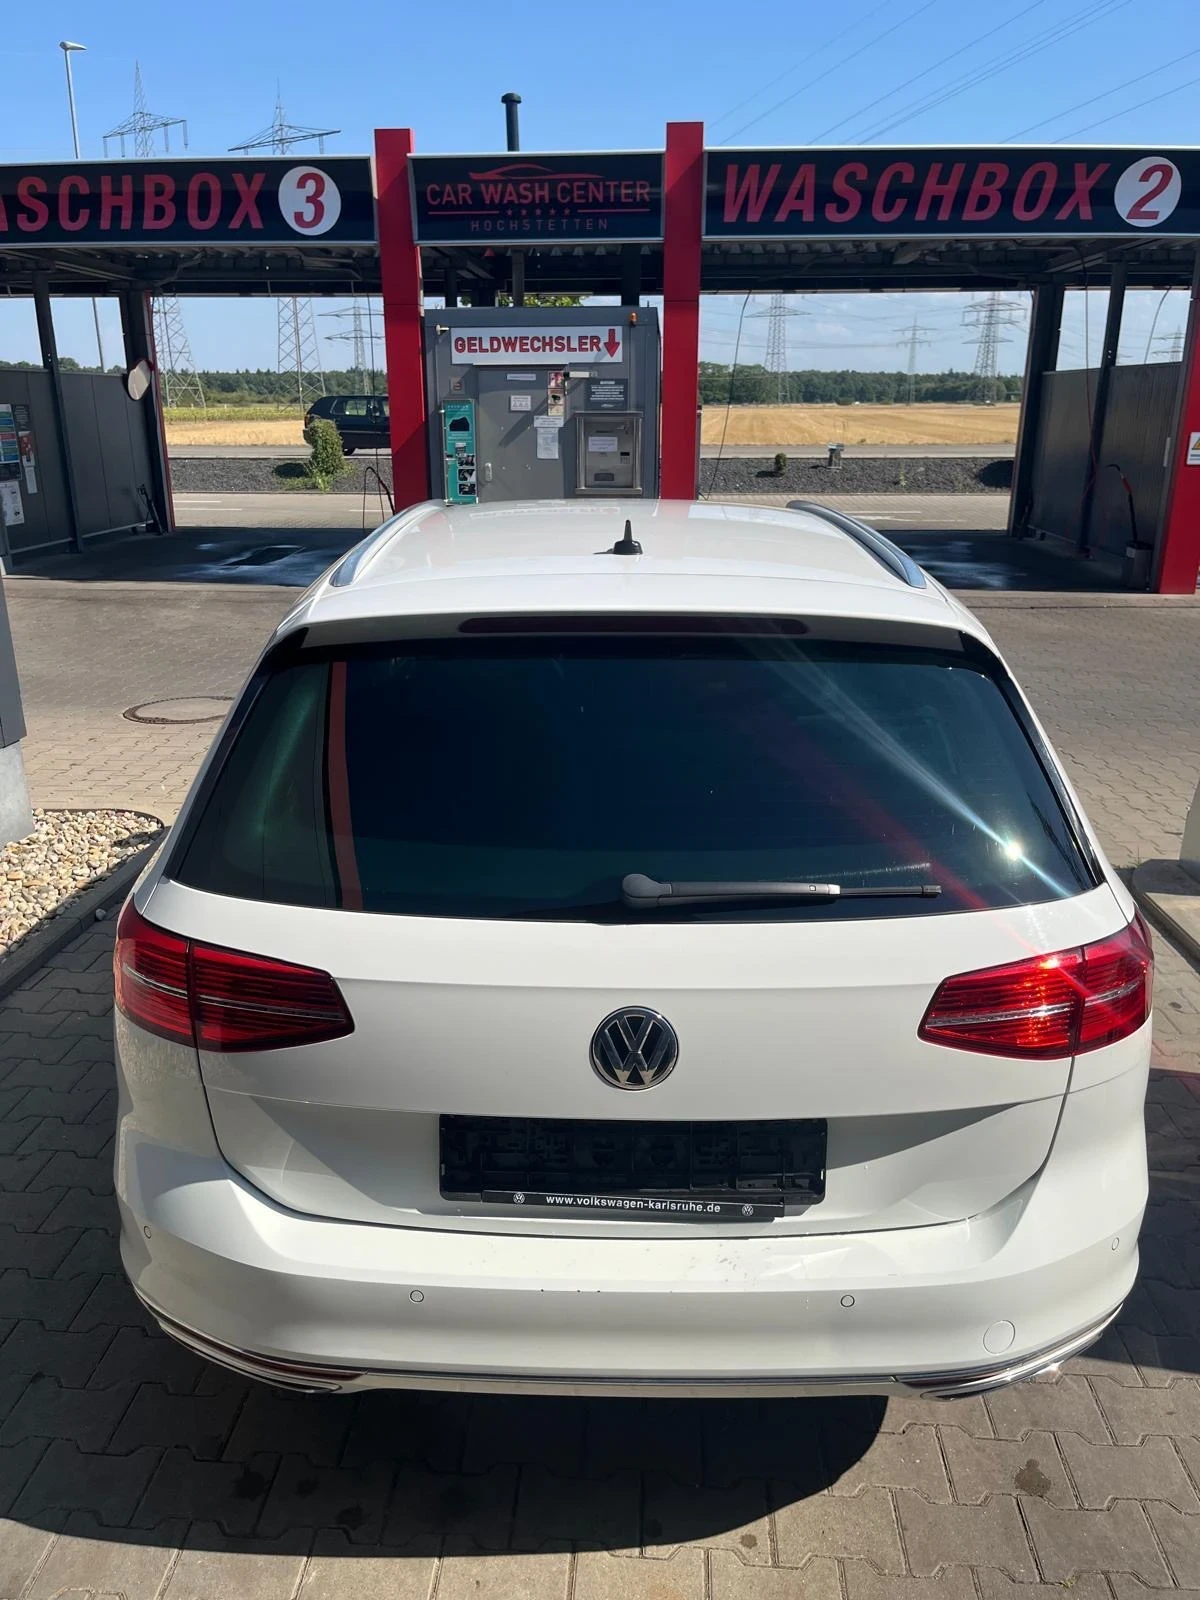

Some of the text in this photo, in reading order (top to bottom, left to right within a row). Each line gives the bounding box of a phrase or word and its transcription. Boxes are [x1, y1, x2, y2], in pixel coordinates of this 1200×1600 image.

[0, 172, 326, 231] SCHBOX 3
[426, 181, 650, 205] CAR WASH CENTER
[722, 161, 1174, 222] WASCHBOX 2
[470, 218, 608, 232] HOCHSTETTEN
[454, 335, 601, 354] GELDWECHSLER
[546, 1195, 721, 1213] www.volkswagen-karlsruhe.de
